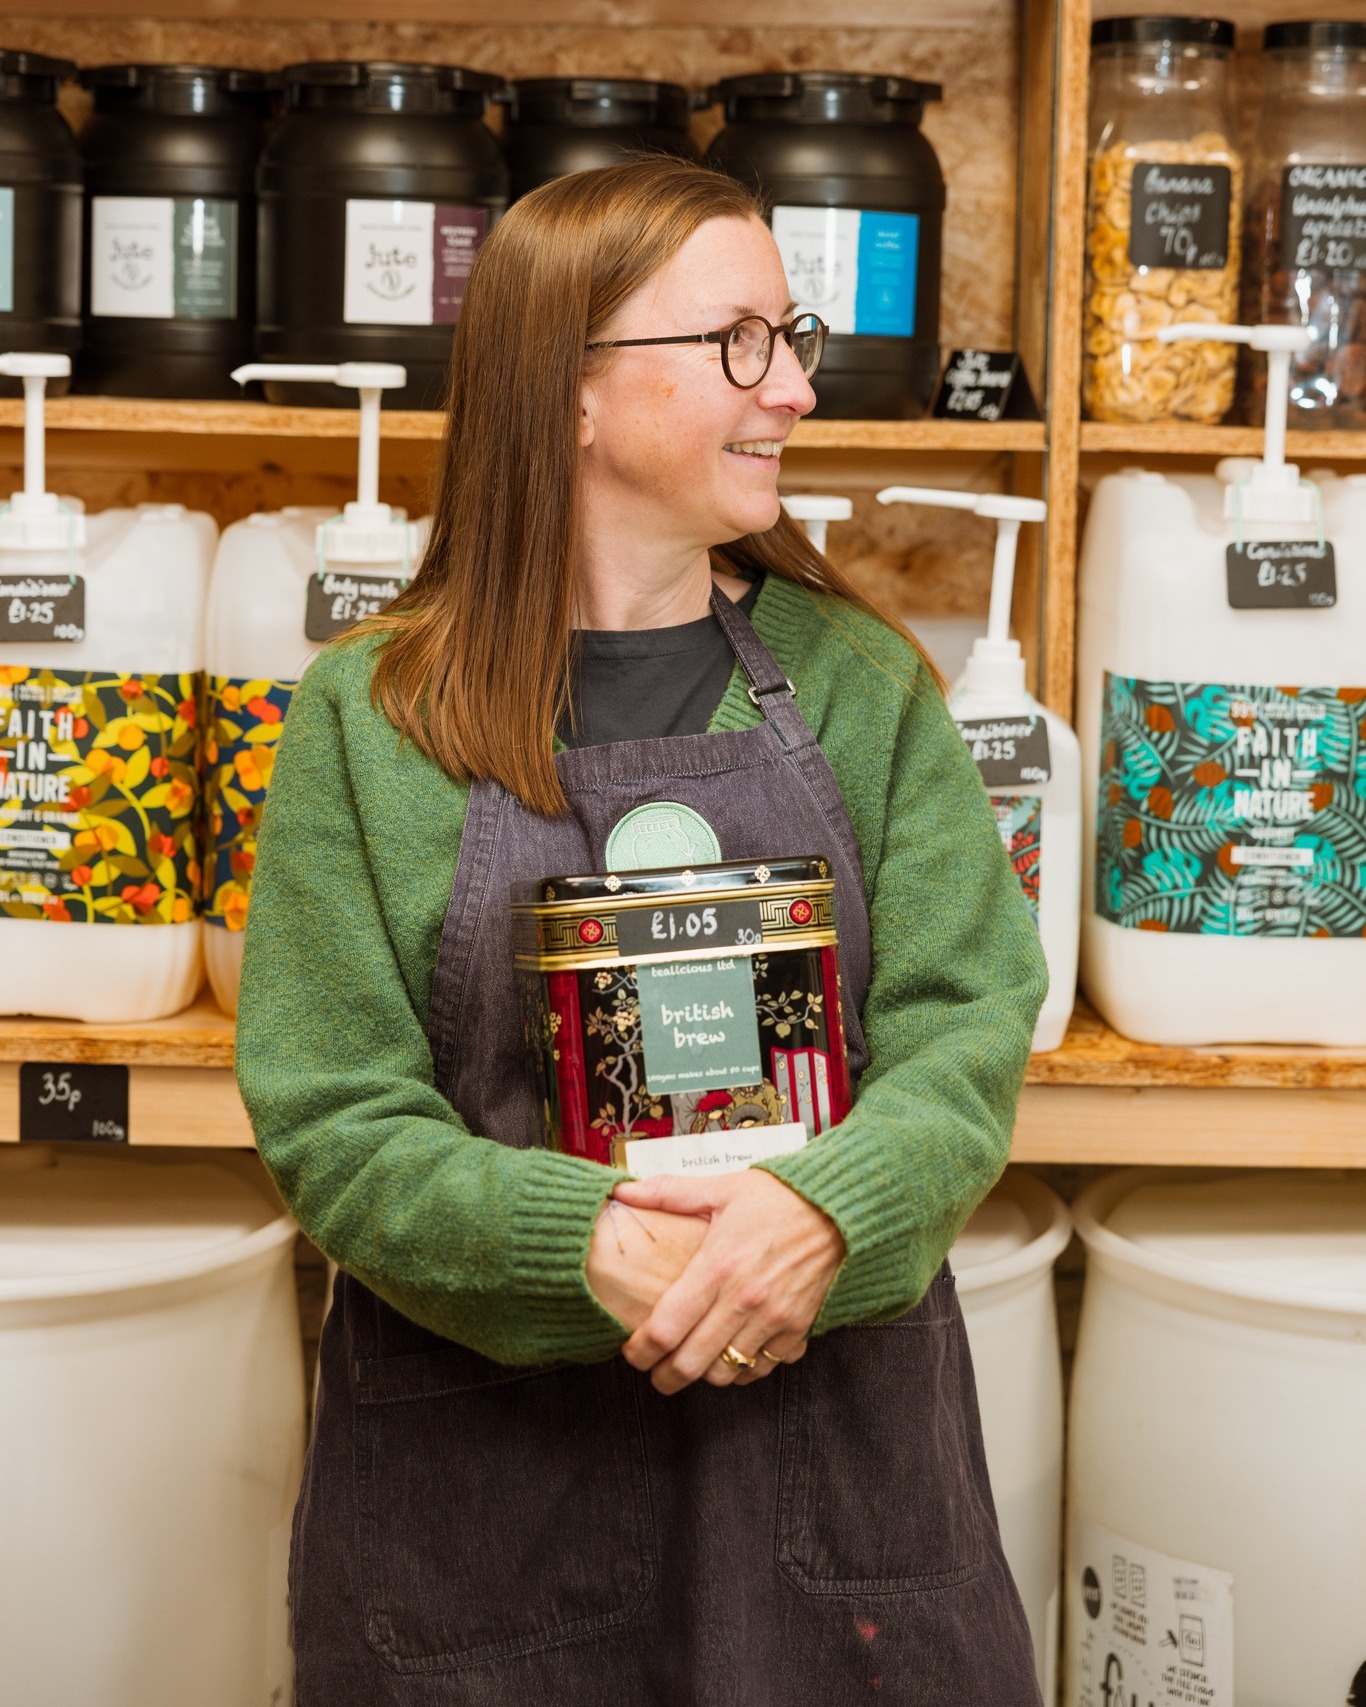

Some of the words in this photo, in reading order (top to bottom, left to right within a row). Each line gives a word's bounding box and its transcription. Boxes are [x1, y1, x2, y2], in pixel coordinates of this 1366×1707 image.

[0, 578, 71, 597] onditioner
[8, 597, 55, 624] £1.25
[957, 722, 1032, 741] onditioner
[1236, 726, 1317, 757] FAITH
[16, 741, 47, 770] IN
[972, 740, 1016, 761] £1.25
[1261, 759, 1291, 788] IN
[1233, 790, 1316, 820] NATURE
[651, 907, 718, 940] £1.05
[735, 928, 762, 945] 30g
[651, 964, 713, 978] tealicious
[717, 958, 736, 971] ltd
[661, 1000, 735, 1026] british
[673, 1026, 726, 1049] brew
[678, 1070, 703, 1079] makes
[705, 1067, 728, 1076] about
[742, 1064, 760, 1075] cups
[38, 1071, 81, 1112] 35p
[92, 1119, 124, 1141] 100g
[681, 1154, 720, 1168] british
[724, 1152, 752, 1164] brew
